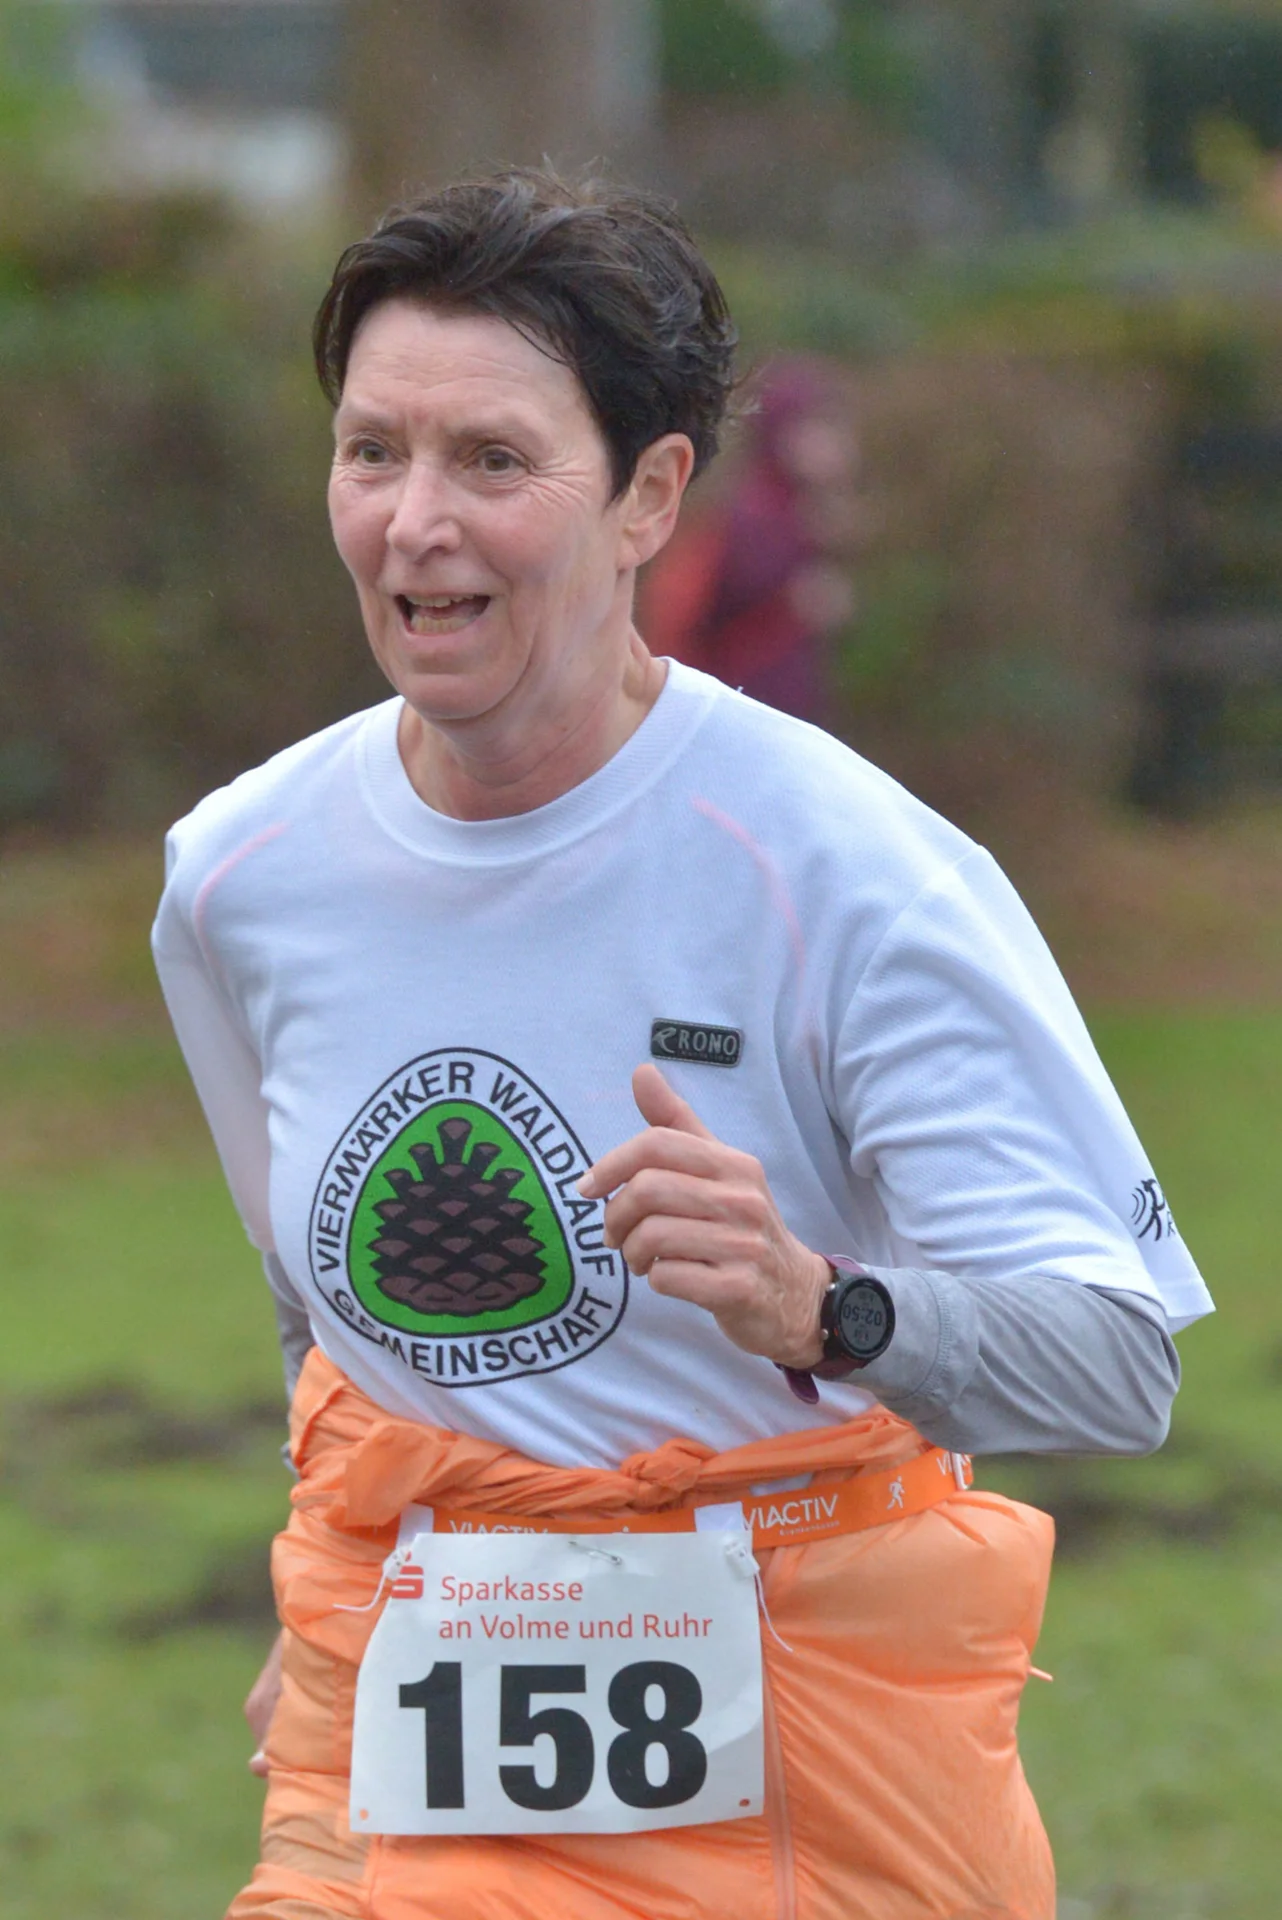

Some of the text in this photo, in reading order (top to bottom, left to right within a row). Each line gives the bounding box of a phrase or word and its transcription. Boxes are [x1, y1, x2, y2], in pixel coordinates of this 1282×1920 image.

[316, 1061, 616, 1277] VIERMÄRKER WALDLAUF
[438, 1612, 713, 1640] an Volme und Ruhr
[440, 1575, 584, 1606] Sparkasse
[398, 1660, 708, 1812] 158
